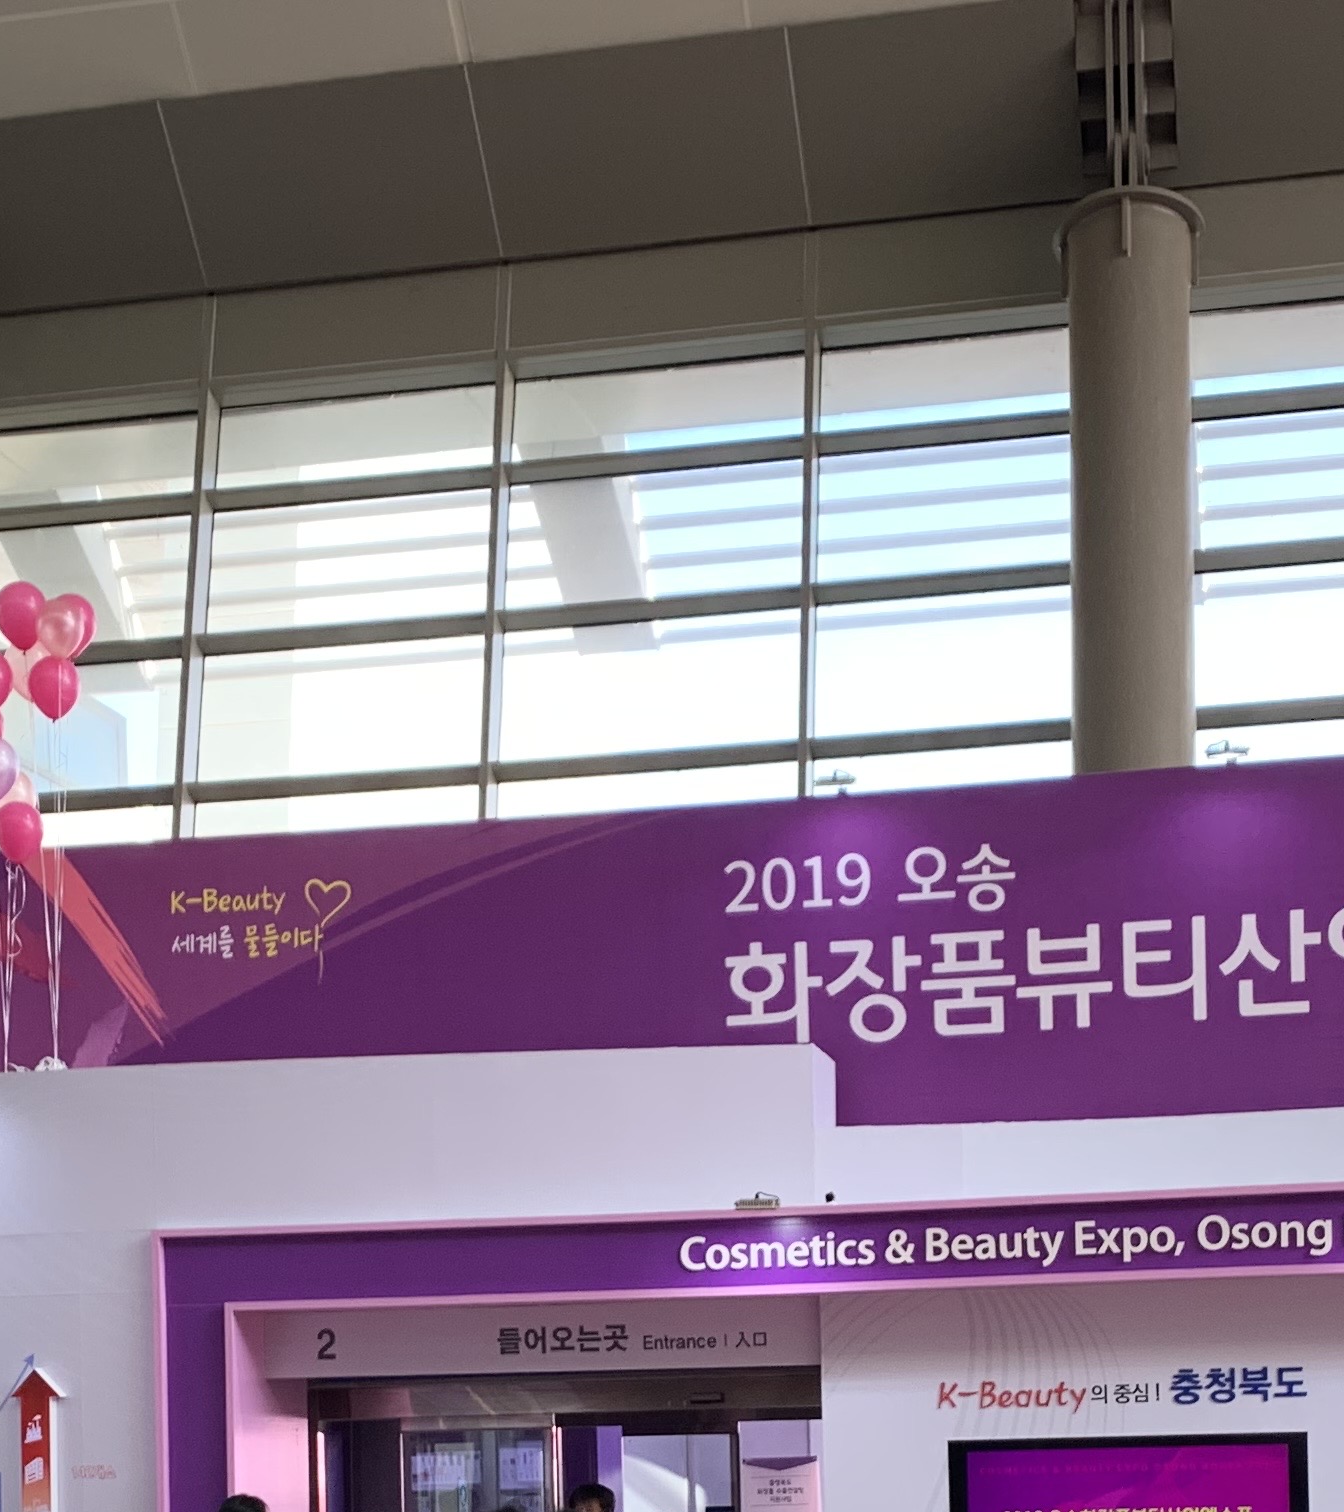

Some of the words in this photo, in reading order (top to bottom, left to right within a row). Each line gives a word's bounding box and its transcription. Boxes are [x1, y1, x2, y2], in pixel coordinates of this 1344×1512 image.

[724, 852, 872, 914] 2019
[896, 843, 1017, 913] 오송
[170, 885, 286, 915] K-Beauty
[171, 925, 234, 959] 세계를
[243, 923, 324, 958] 물들이다
[679, 1231, 876, 1273] Cosmetics
[885, 1232, 915, 1265] &
[926, 1224, 1064, 1270] Beauty
[1074, 1219, 1185, 1262] Expo,
[1196, 1212, 1334, 1256] Osong
[316, 1328, 337, 1360] 2
[497, 1324, 629, 1355] 들어오는곳
[643, 1334, 717, 1350] Entrance
[735, 1331, 767, 1349] 入口
[1169, 1366, 1308, 1406] 충청북도
